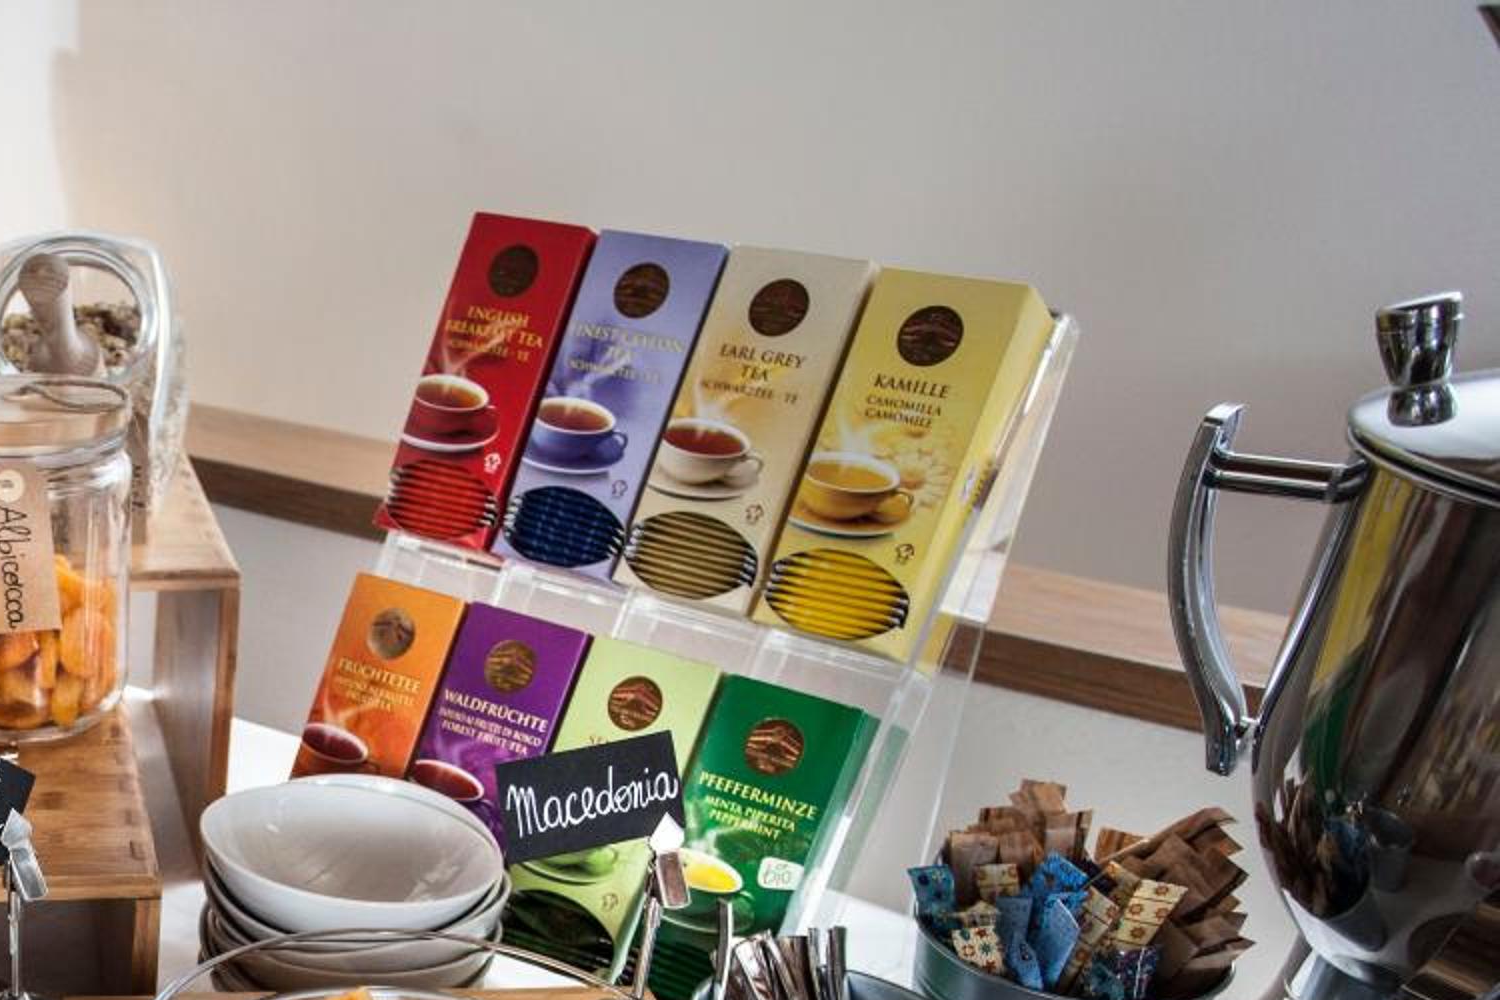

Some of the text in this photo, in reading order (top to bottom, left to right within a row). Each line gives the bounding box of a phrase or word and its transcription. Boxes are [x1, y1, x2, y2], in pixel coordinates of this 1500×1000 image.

[518, 330, 542, 348] TEA
[720, 343, 806, 368] EARL GREY
[741, 364, 769, 381] TEA
[873, 373, 949, 398] KAMILLE
[866, 395, 941, 416] CAMOMILLA
[444, 688, 549, 733] WALDFRÜCHTE
[441, 719, 528, 756] FOREST FRUIT TEA
[513, 730, 543, 747] BOSCO
[506, 765, 678, 839] Macedonia
[699, 771, 818, 820] PFEFFERMINZE
[705, 795, 795, 832] MENTA PIPERITA
[708, 808, 781, 840] PEPPERMINT
